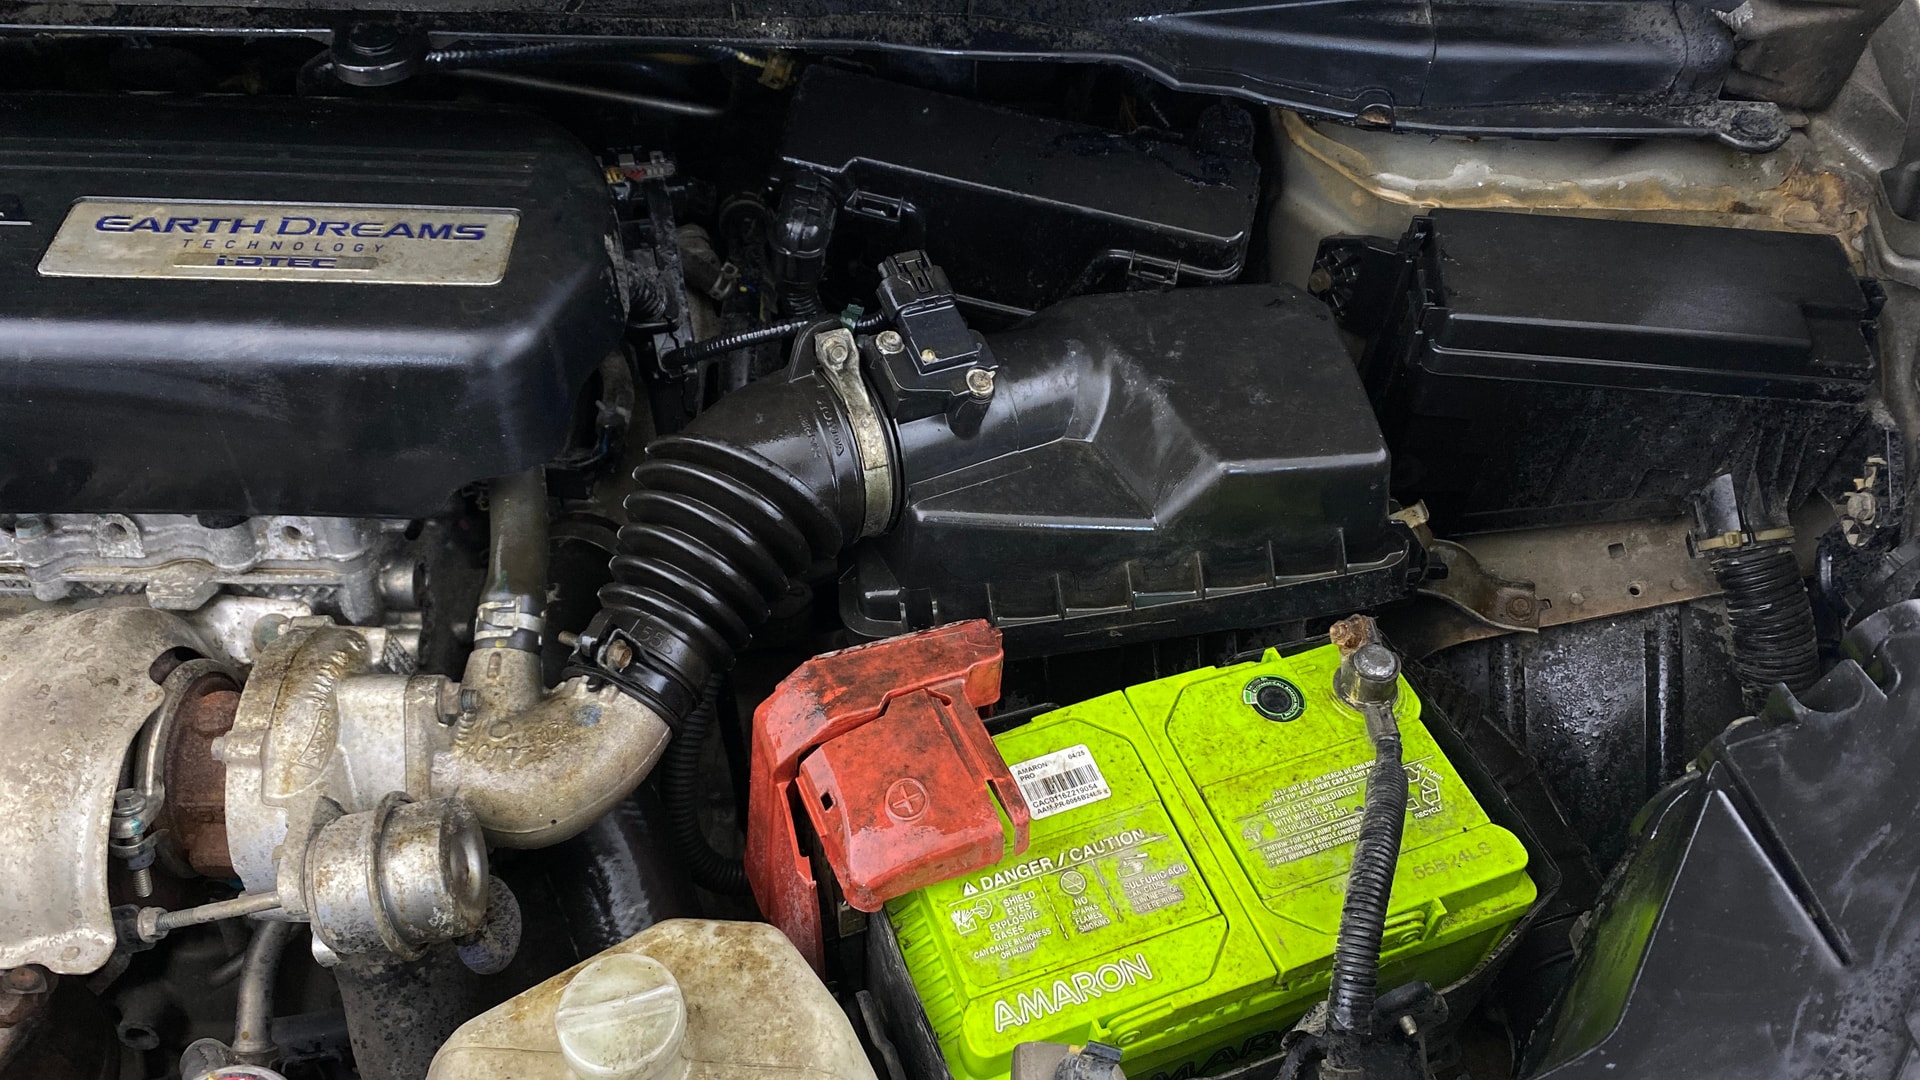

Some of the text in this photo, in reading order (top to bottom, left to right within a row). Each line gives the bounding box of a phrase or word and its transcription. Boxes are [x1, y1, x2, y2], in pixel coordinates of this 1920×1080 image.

[95, 215, 488, 241] EARTH DREAMS
[183, 238, 384, 252] TECHNOLOGY
[216, 254, 337, 269] i-DTEC
[1067, 750, 1086, 760] 04/25
[1017, 761, 1048, 776] AMARON
[1416, 763, 1443, 781] RETURN
[1020, 772, 1036, 782] PRO
[1267, 784, 1359, 819] FLUSH EYES IMMEDIATELY
[1273, 815, 1294, 828] WITH
[1322, 801, 1336, 812] GET
[1414, 805, 1443, 819] RECYCLE
[1277, 806, 1348, 836] MEDICAL HELP FAST
[980, 857, 1054, 891] DANGER
[1069, 828, 1145, 861] CAUTION
[1123, 864, 1188, 891] SULFURIC ACID
[1144, 881, 1166, 893] CAUSE
[1003, 890, 1036, 907] SHIELD
[1074, 896, 1088, 906] NO
[1007, 901, 1032, 916] EYES
[1072, 904, 1099, 916] SPARKS
[989, 910, 1039, 932] EXPLOSIVE
[1075, 912, 1103, 925] FLAMES
[1078, 918, 1111, 932] SMOKING
[993, 925, 1025, 941] GASES
[974, 928, 1051, 959] CAN CAUSE BLINDNESS
[1001, 941, 1037, 959] OR INJURY
[994, 952, 1153, 1033] AMARON
